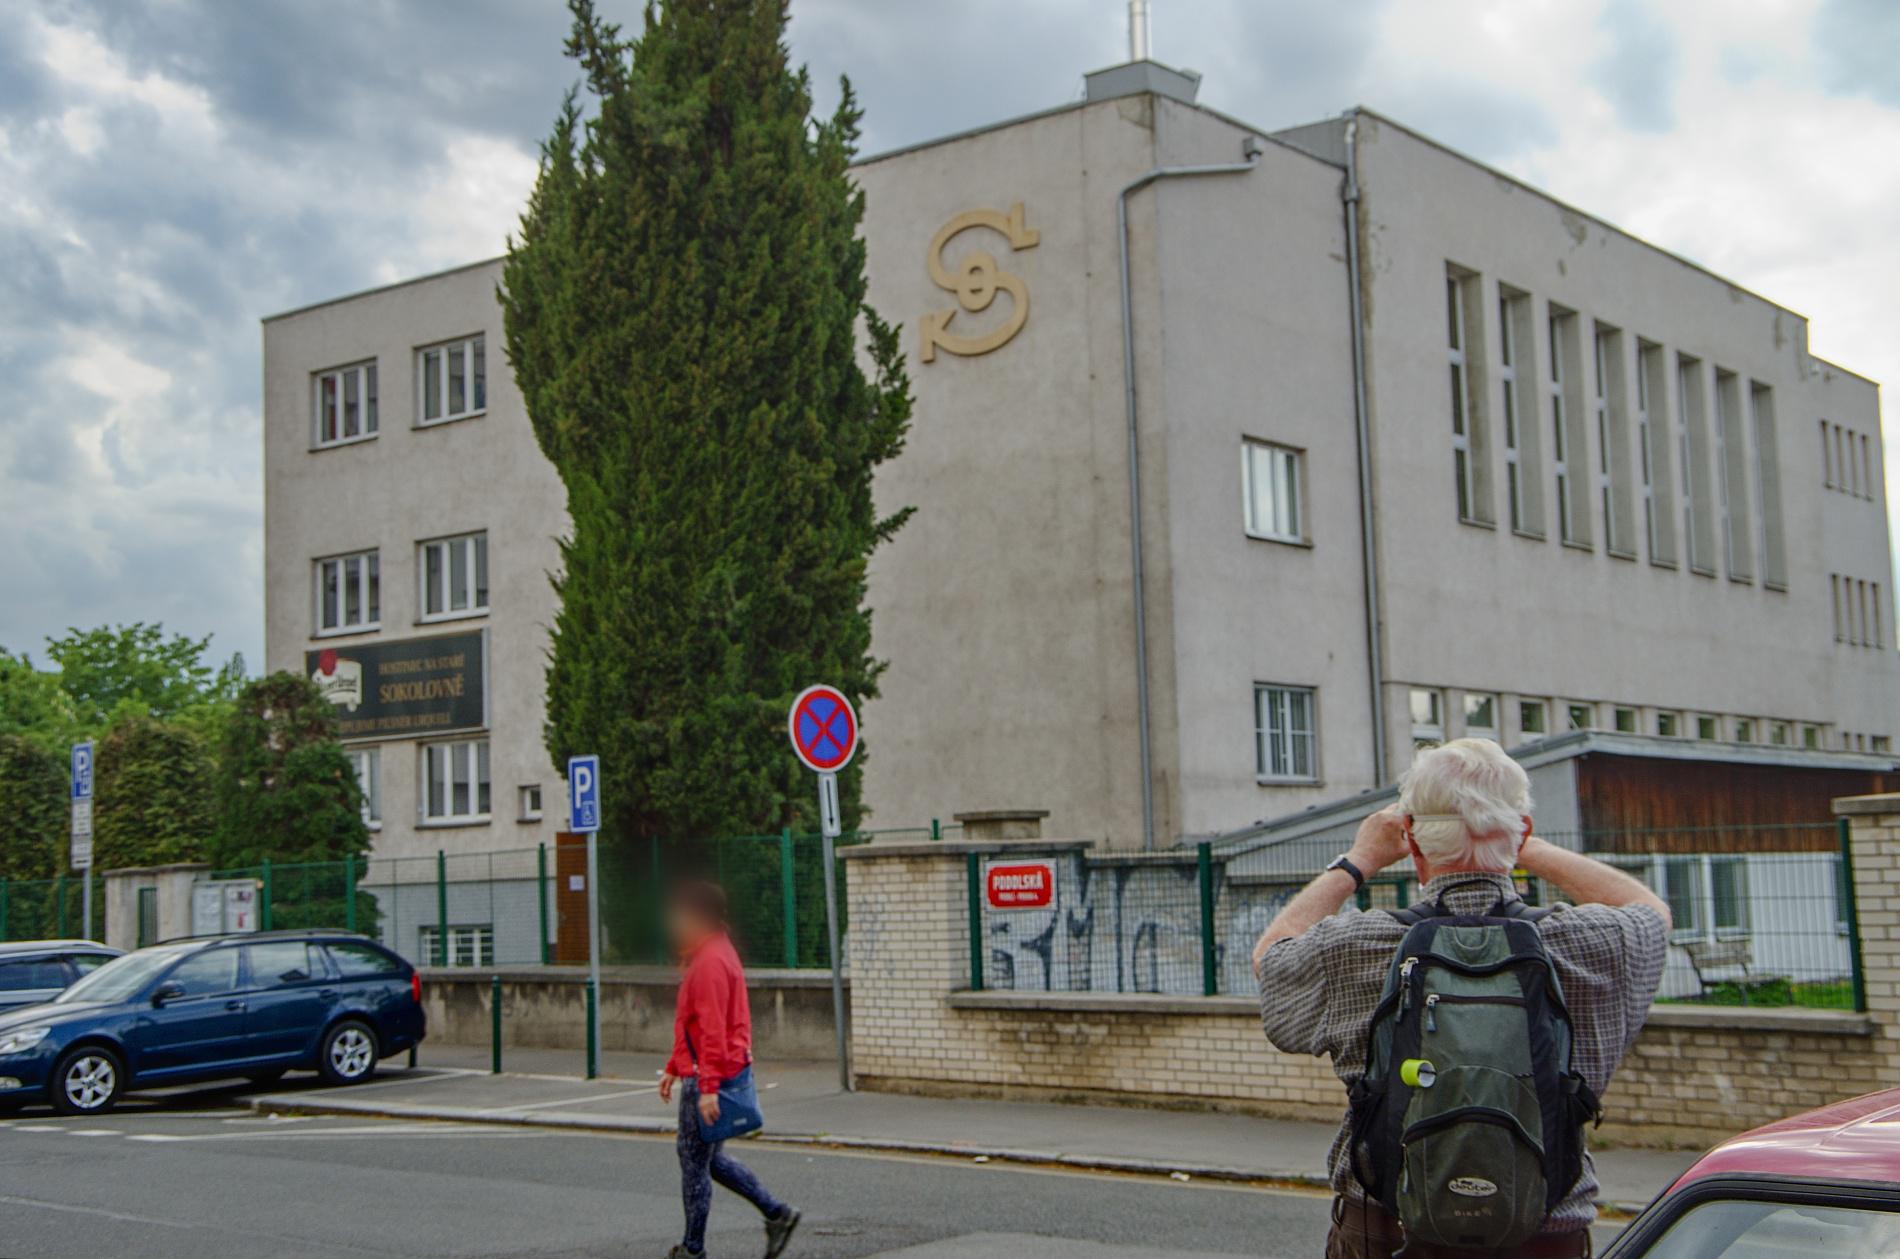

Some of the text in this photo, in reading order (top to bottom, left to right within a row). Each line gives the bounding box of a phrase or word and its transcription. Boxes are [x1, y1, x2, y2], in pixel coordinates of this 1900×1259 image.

[379, 672, 464, 703] SOKOLOVNĚ
[574, 766, 592, 809] P
[992, 871, 1044, 891] PODOLSKÁ
